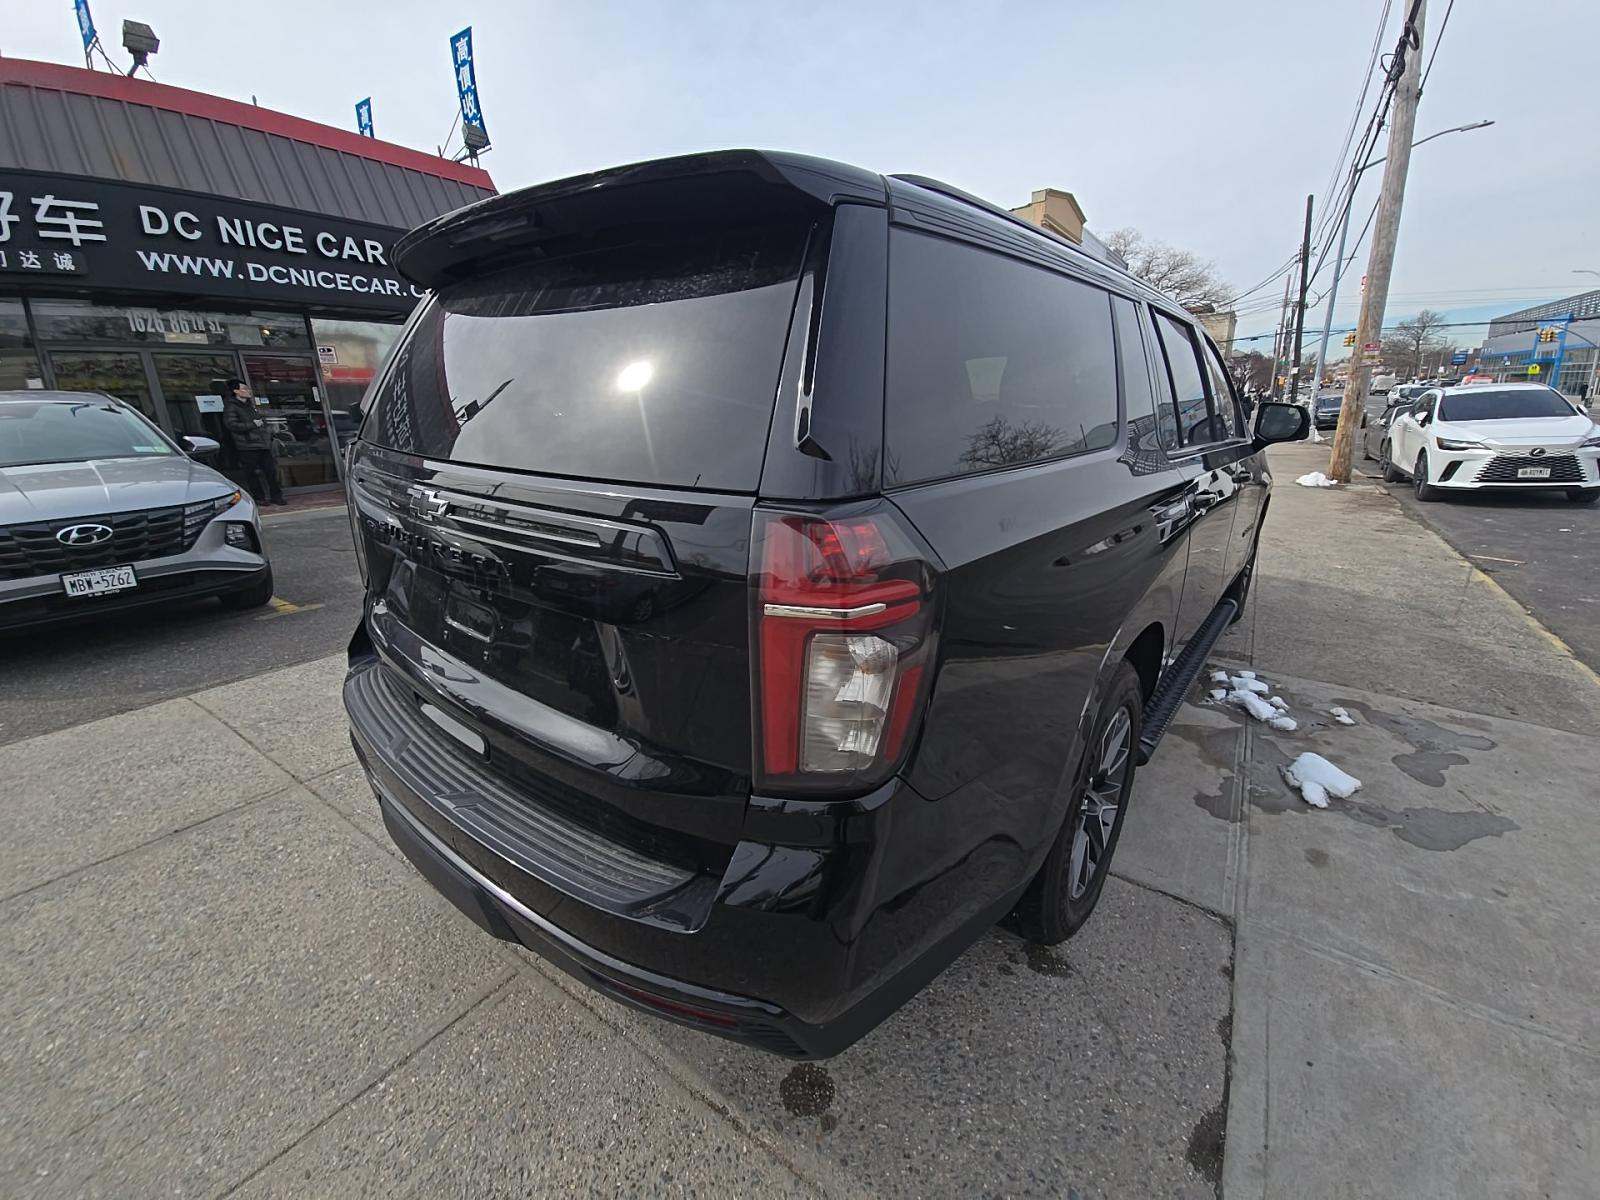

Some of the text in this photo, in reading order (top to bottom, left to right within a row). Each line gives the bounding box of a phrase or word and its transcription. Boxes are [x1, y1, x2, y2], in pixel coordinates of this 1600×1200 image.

[139, 205, 388, 266] DC NICE CAR
[0, 250, 75, 271] 达诚
[126, 310, 165, 333] 1626
[68, 577, 94, 593] MBW
[100, 571, 133, 589] 5262
